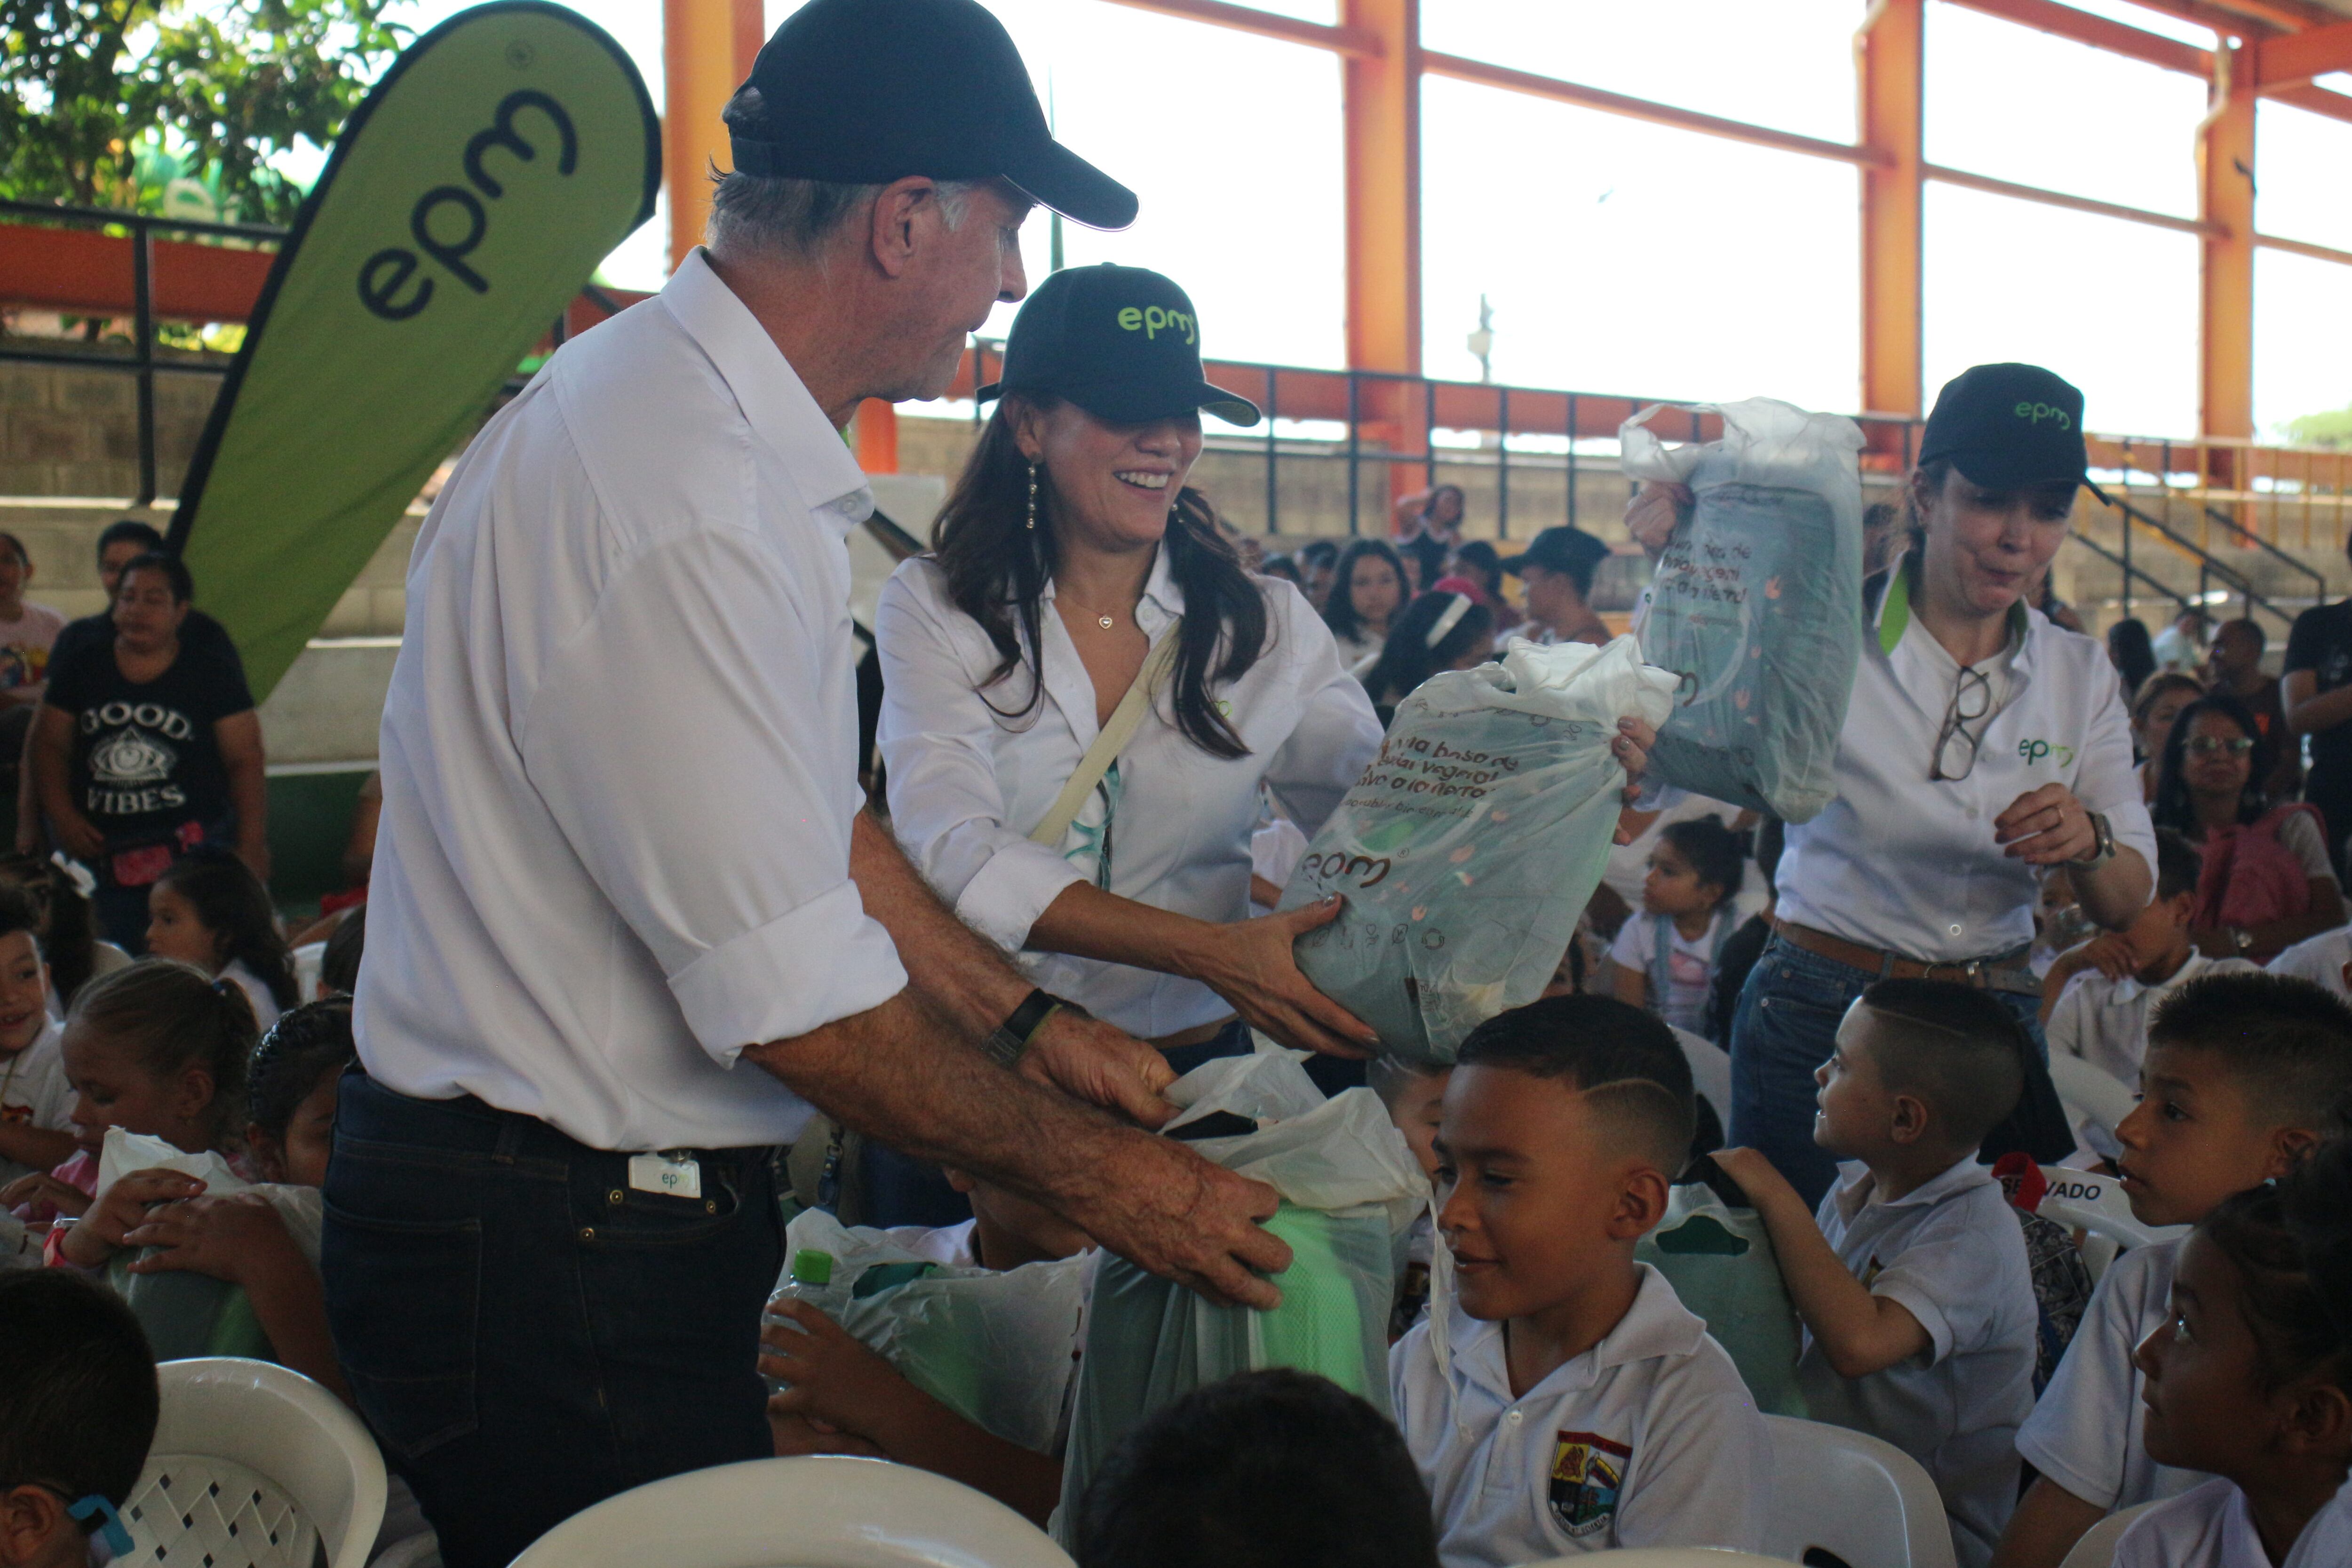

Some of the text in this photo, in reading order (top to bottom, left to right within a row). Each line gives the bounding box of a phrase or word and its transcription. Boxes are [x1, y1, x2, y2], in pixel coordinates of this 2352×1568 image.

[357, 89, 578, 322] epm
[1118, 306, 1195, 345] epm
[2015, 402, 2071, 430] epm
[2019, 739, 2074, 768] epm
[87, 784, 186, 814] VIBES
